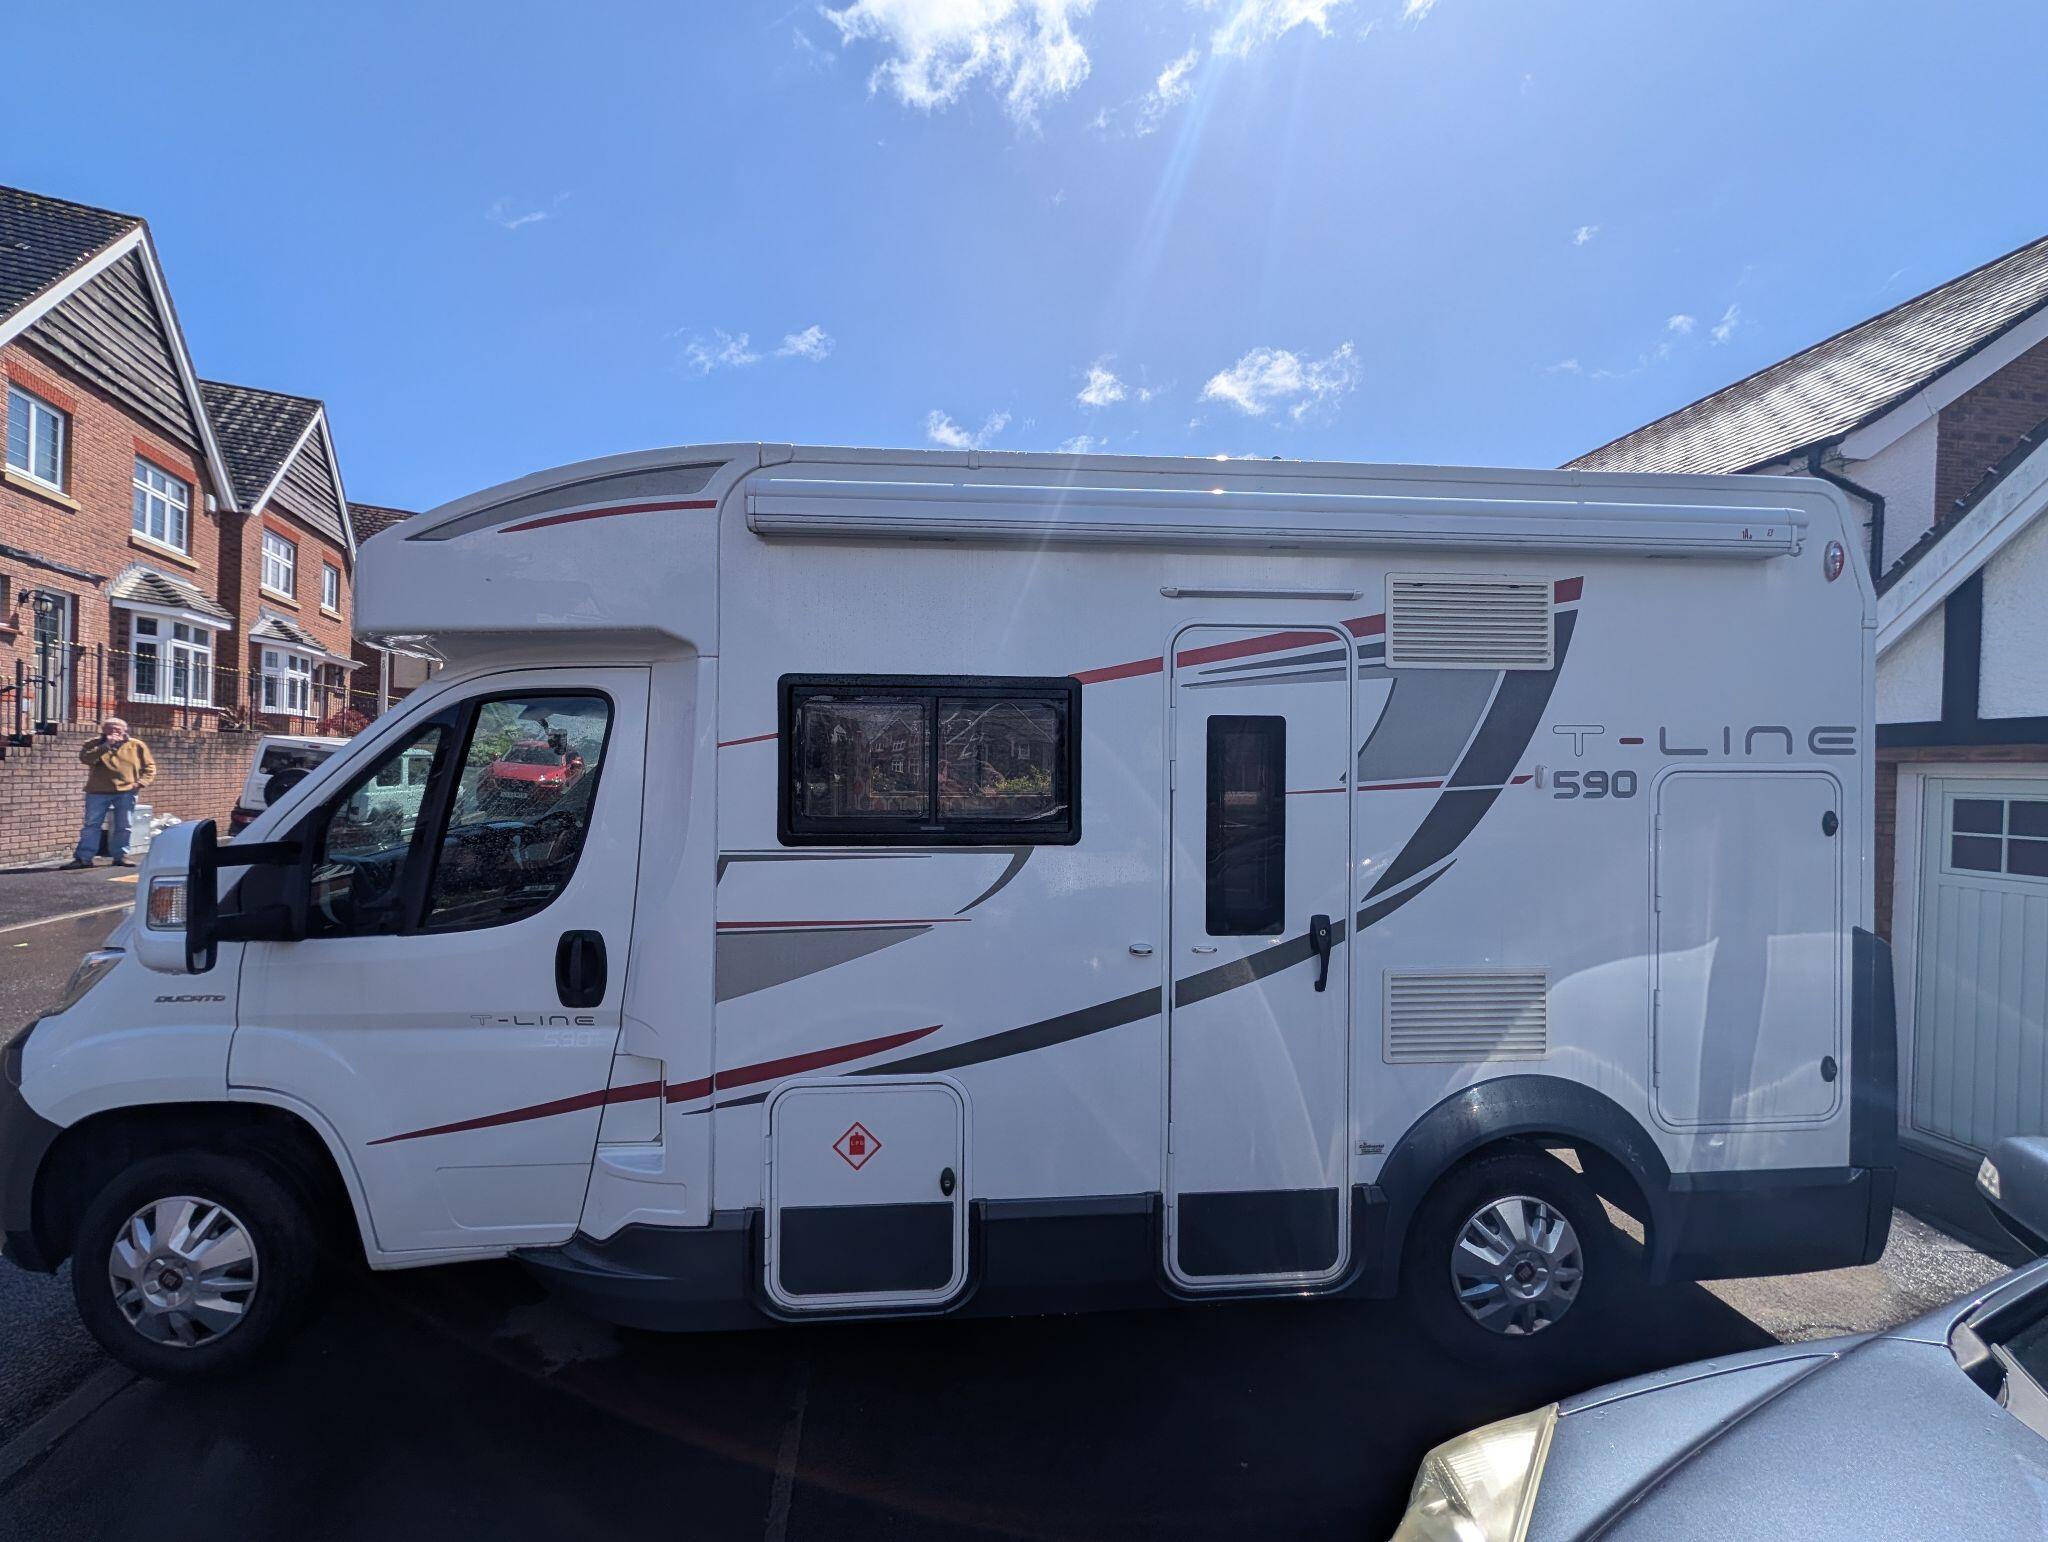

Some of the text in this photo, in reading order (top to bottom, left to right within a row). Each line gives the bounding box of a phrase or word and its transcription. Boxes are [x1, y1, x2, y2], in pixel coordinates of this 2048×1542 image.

[1552, 725, 1857, 757] T-LINE
[1554, 770, 1637, 799] 590
[155, 995, 226, 1003] DUCATO
[471, 1014, 594, 1026] T-LINE
